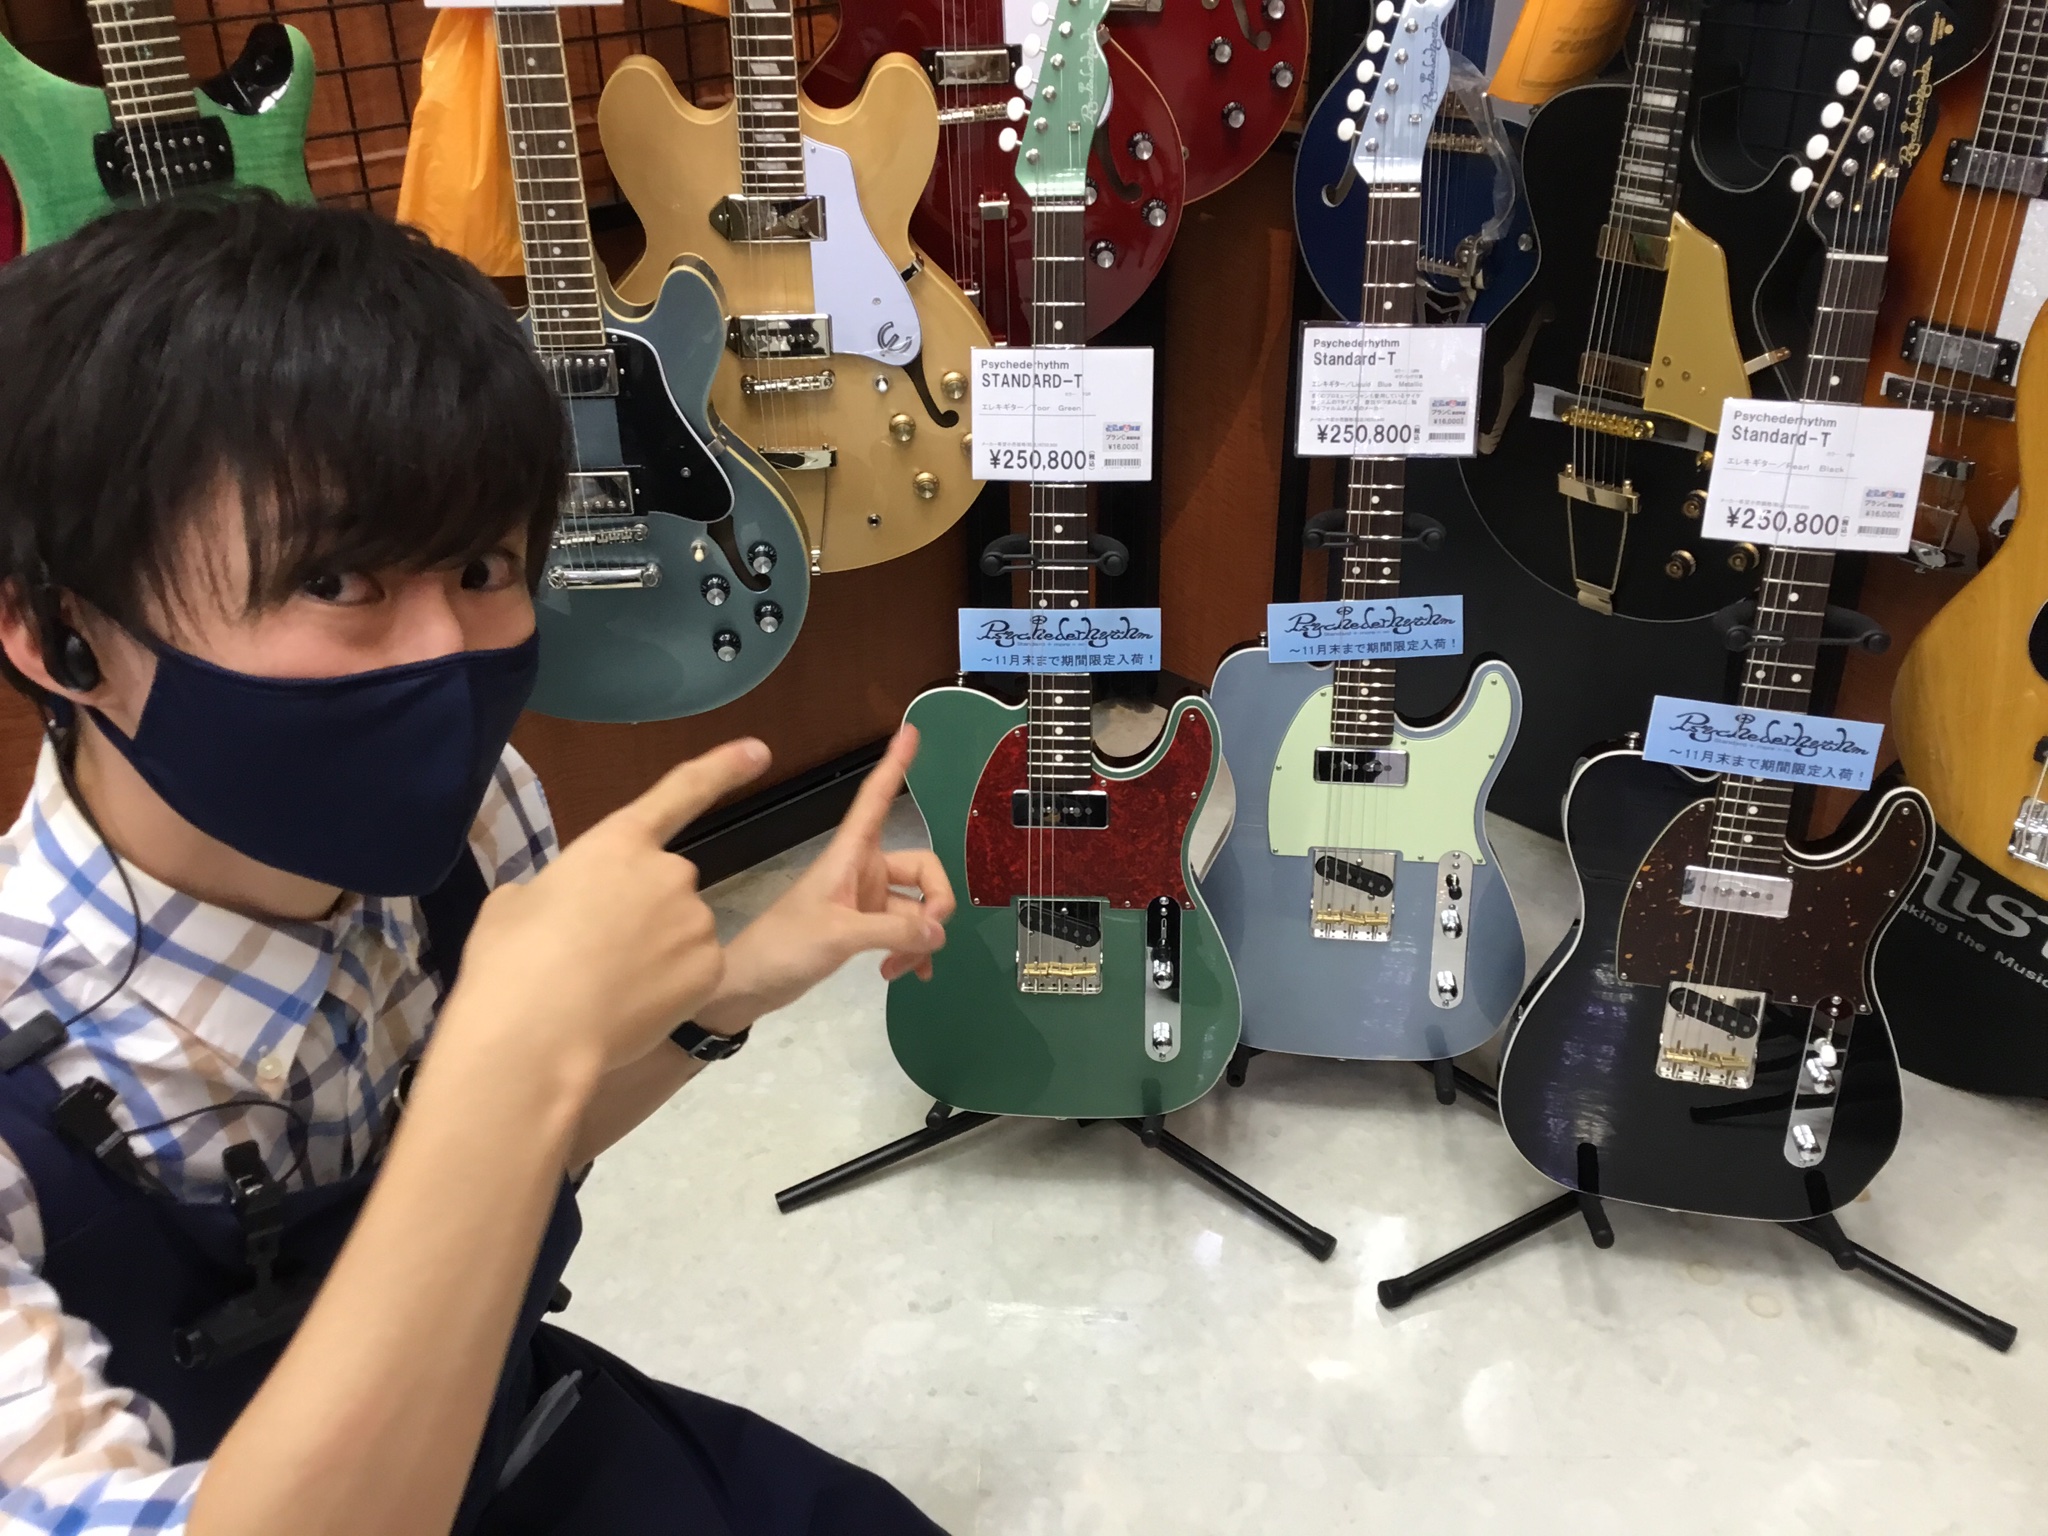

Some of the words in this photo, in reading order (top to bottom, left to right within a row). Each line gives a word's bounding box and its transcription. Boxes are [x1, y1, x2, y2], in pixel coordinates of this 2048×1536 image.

[1313, 338, 1400, 348] Psychederhythm
[1313, 351, 1396, 366] Standard-T
[982, 373, 1083, 389] STANDARD-T
[1733, 410, 1837, 427] Psychederhythm
[1317, 424, 1412, 444] ¥250,800
[1731, 425, 1832, 447] Standard-T
[990, 449, 1086, 471] ¥250,800
[1819, 464, 1845, 474] Black
[1956, 931, 1987, 953] the
